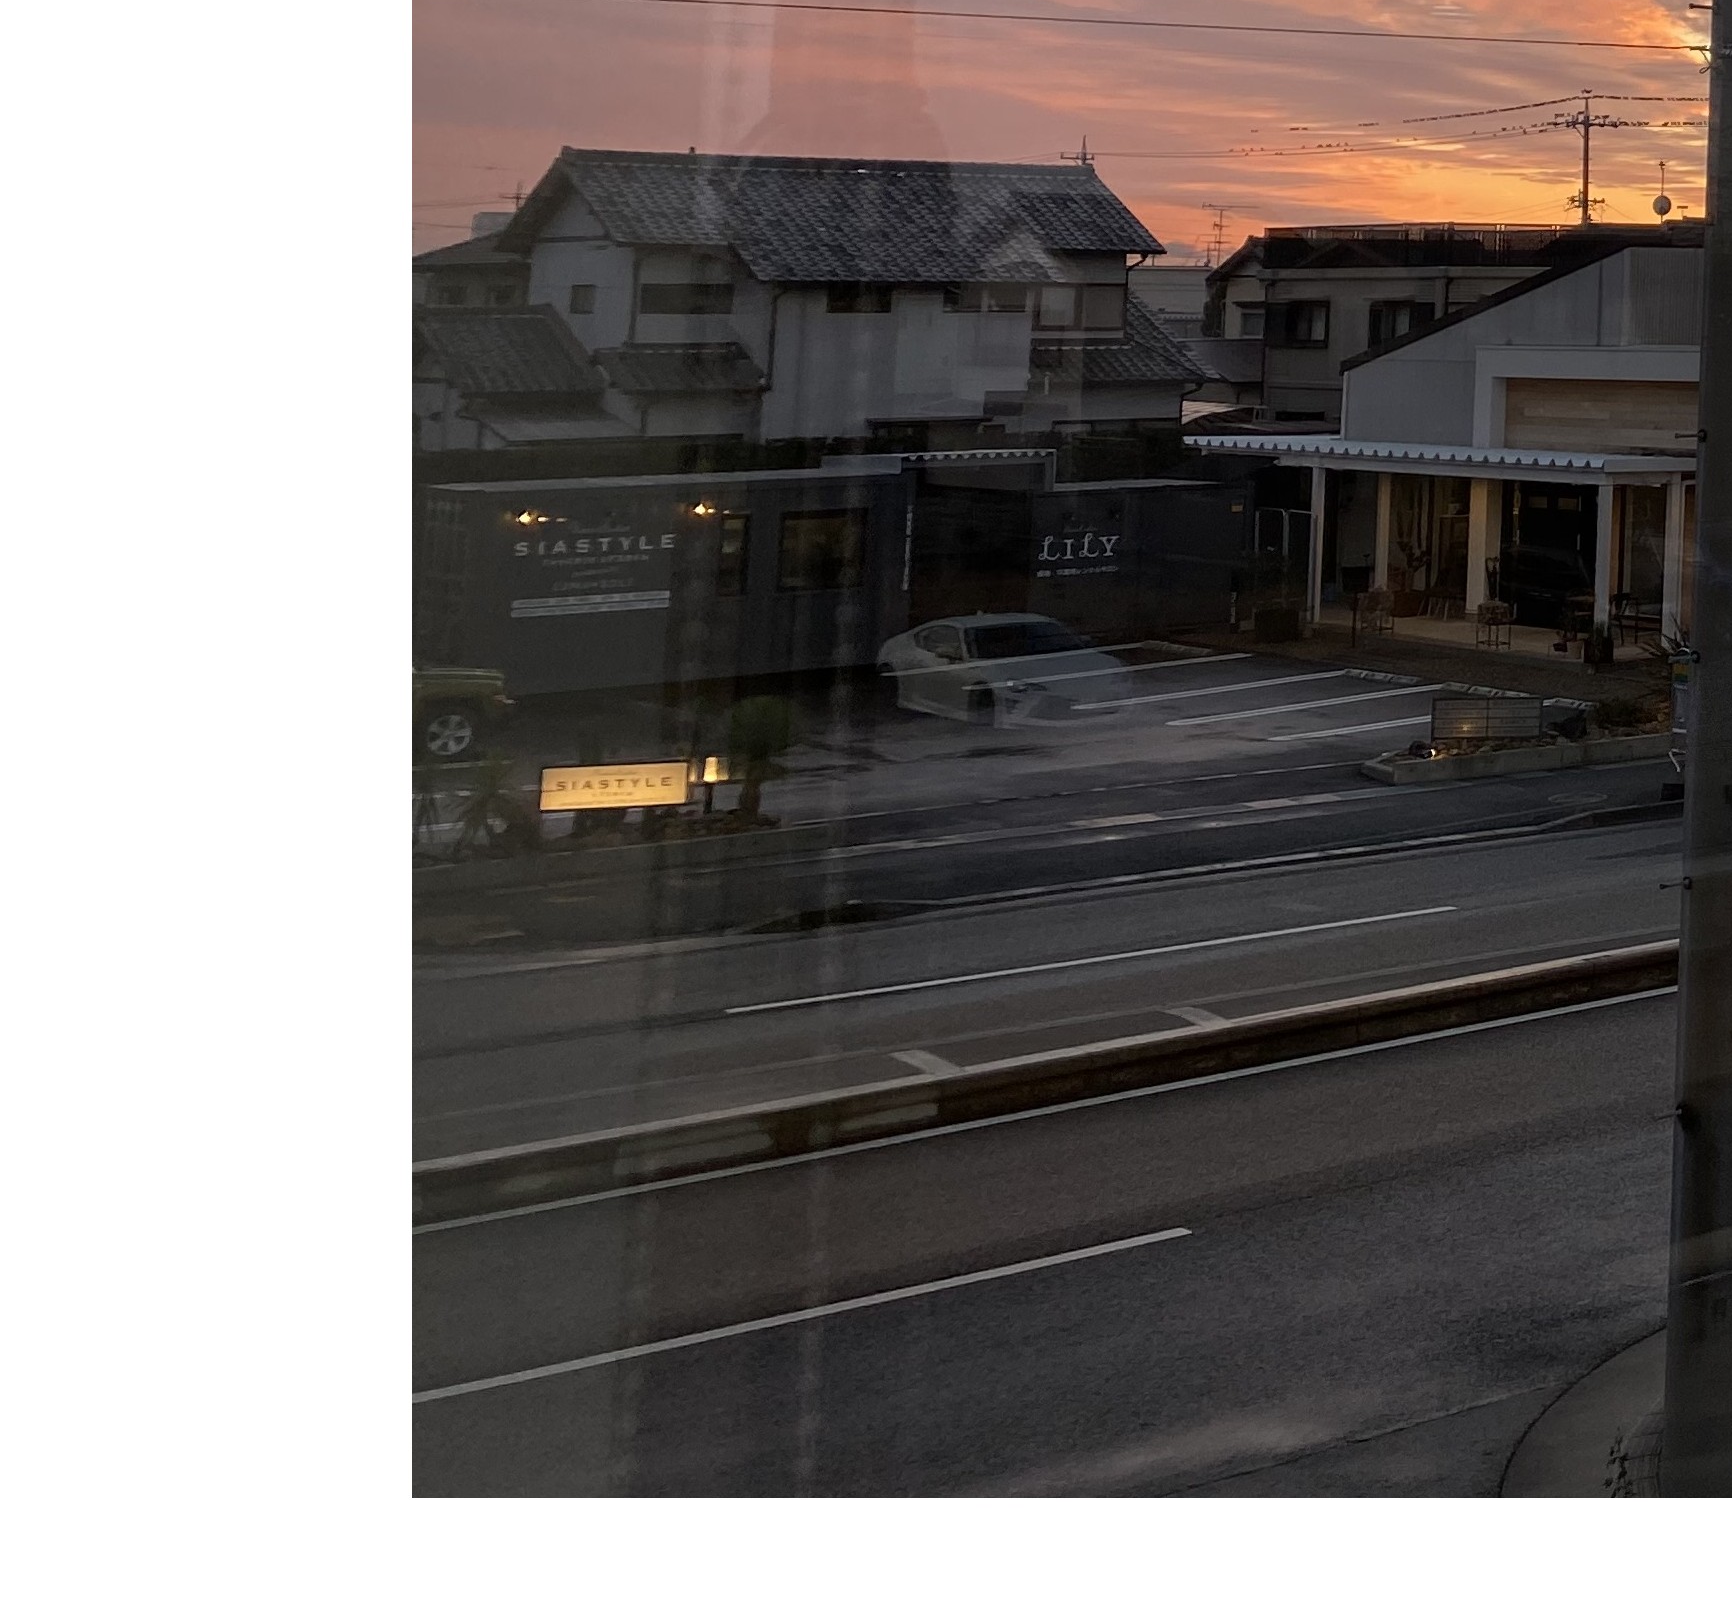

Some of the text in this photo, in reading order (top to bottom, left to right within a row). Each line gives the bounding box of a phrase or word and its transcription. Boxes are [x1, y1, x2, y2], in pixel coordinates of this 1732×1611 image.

[513, 534, 677, 557] SIASTYLE
[1038, 533, 1120, 560] LILY
[556, 776, 674, 791] SIASTYLE
